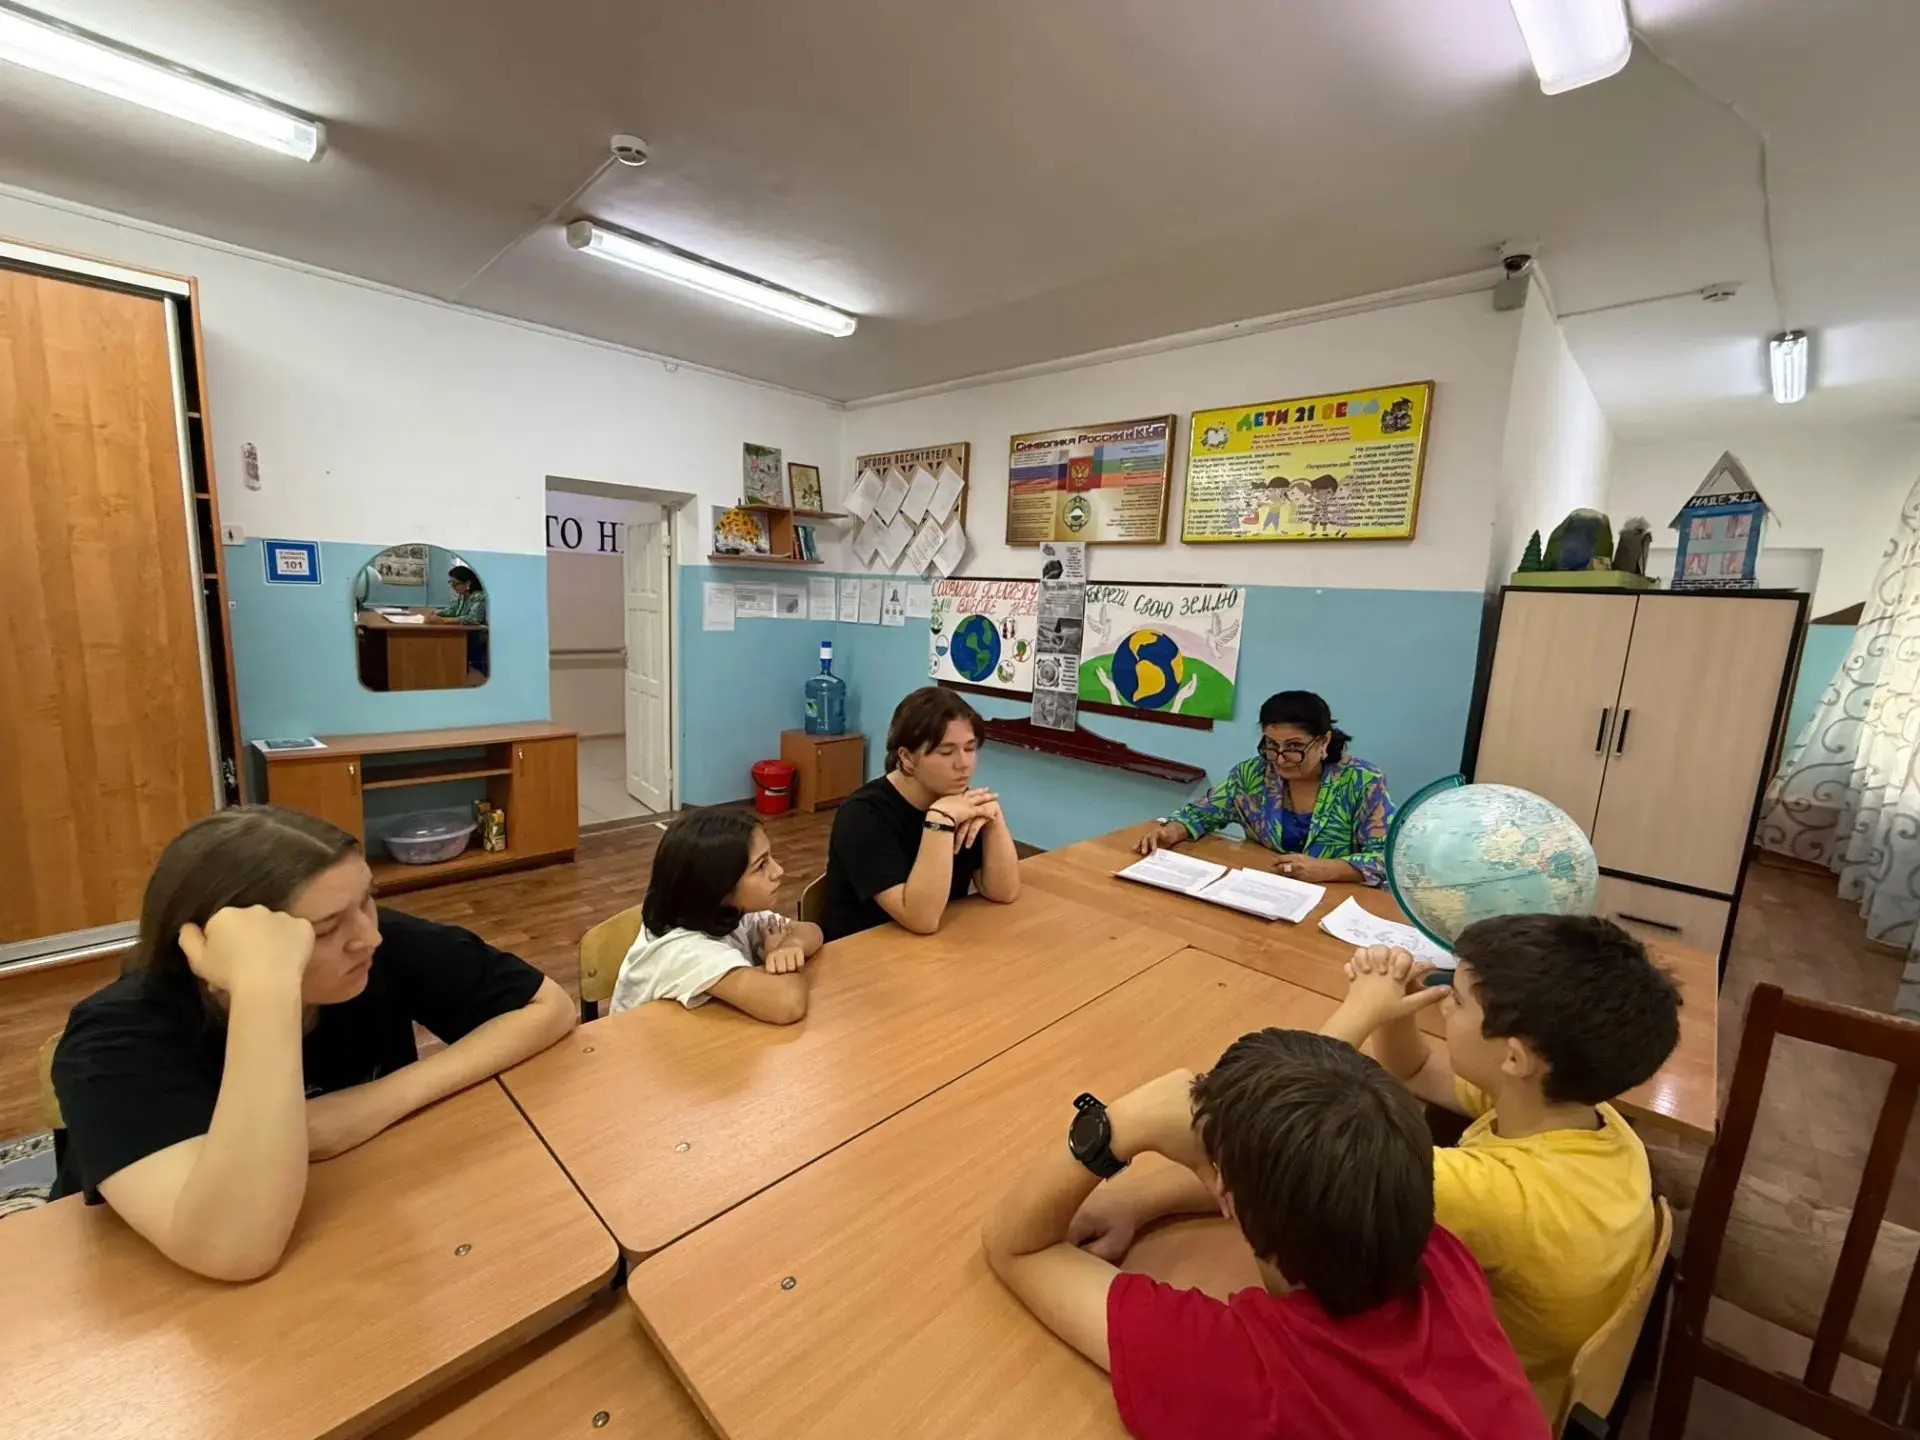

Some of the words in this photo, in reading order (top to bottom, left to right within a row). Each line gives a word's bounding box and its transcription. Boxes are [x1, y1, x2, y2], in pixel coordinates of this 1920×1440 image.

[1236, 408, 1289, 432] ДЕТИ
[1294, 405, 1315, 422] 21
[597, 520, 624, 553] Н
[283, 561, 303, 569] 101
[1179, 588, 1238, 616] ЗЕМЛЮ
